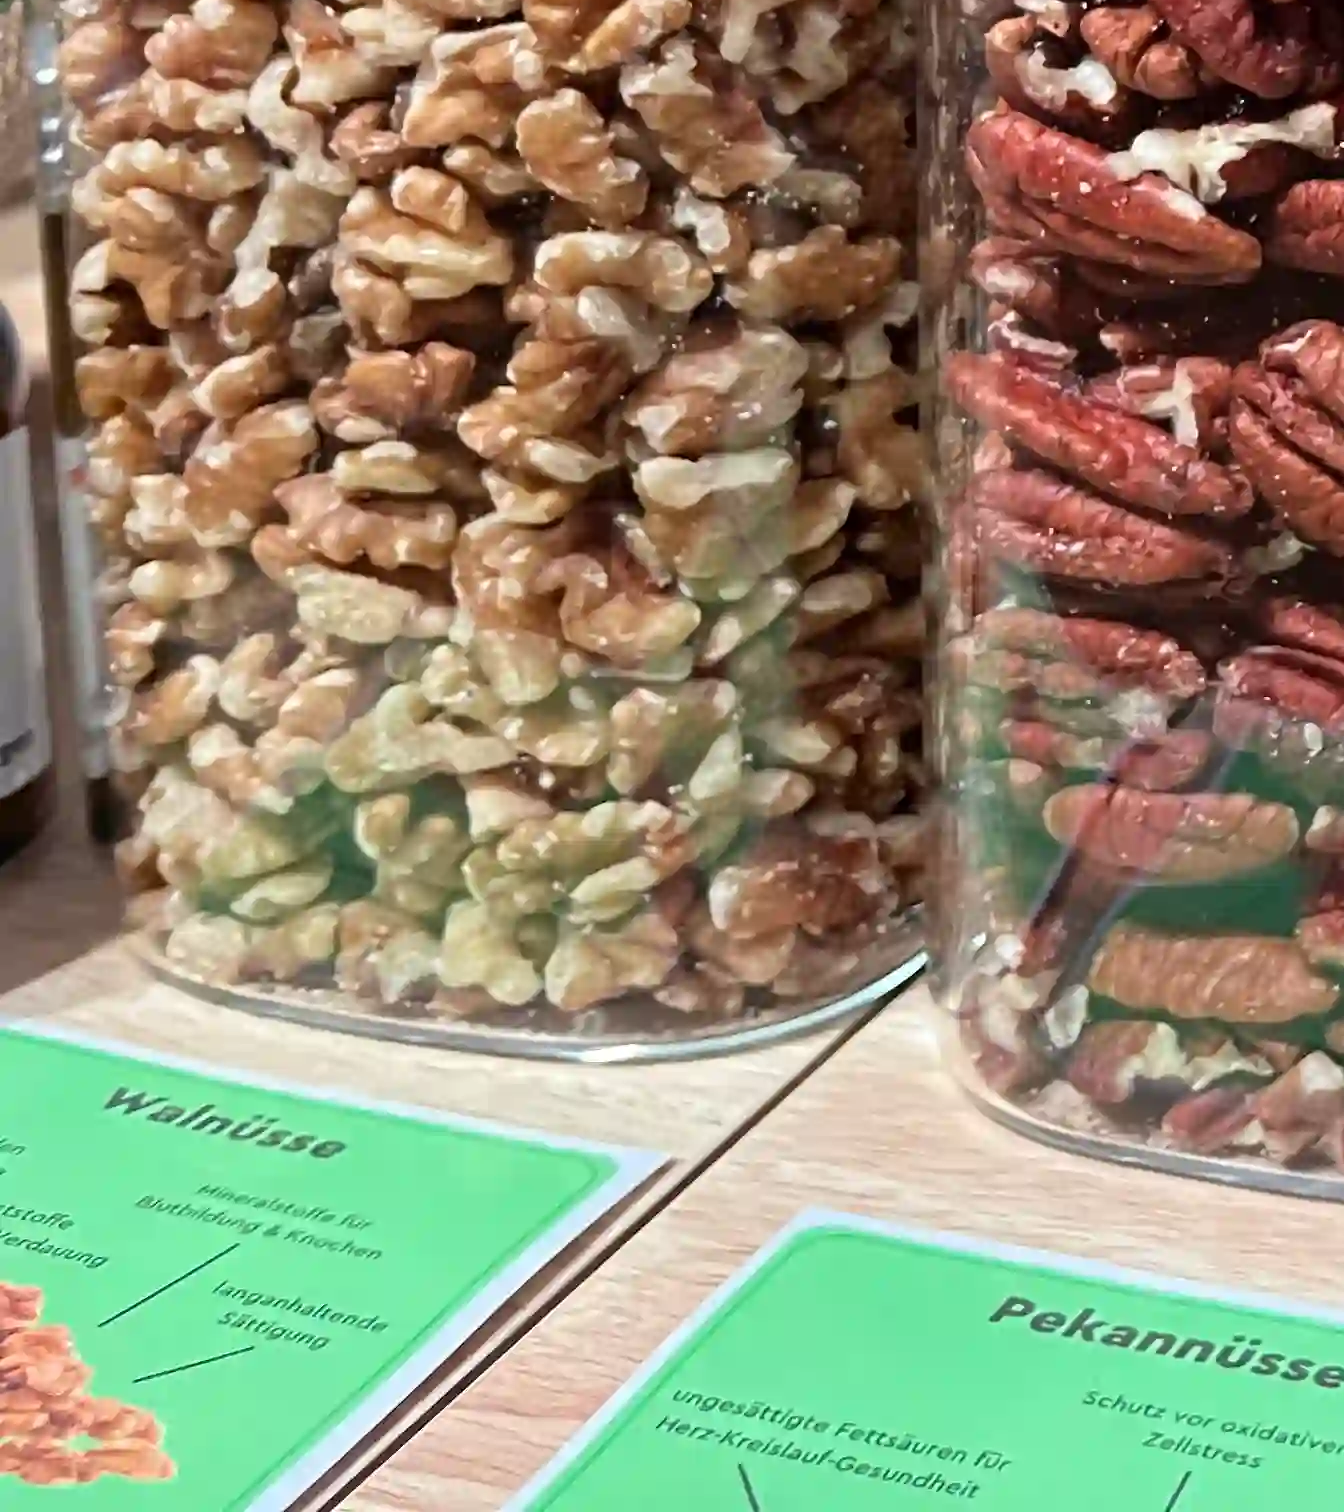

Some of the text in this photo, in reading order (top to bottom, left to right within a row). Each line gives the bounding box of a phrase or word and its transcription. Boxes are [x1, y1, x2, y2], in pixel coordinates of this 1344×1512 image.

[103, 1086, 348, 1159] Walnüsse
[134, 1194, 384, 1260] Blutbildung & Knochen
[196, 1183, 375, 1231] Mineralstoffe für
[211, 1279, 390, 1334] langanhaltende
[216, 1310, 332, 1351] Sättigung
[672, 1388, 1013, 1473] ungesättigte Fettsäuren für
[1081, 1389, 1168, 1420] Schutz
[1174, 1409, 1217, 1430] vor
[655, 1414, 982, 1500] Herz-Kreislauf-Gesundheit
[1142, 1430, 1267, 1470] Zellstress
